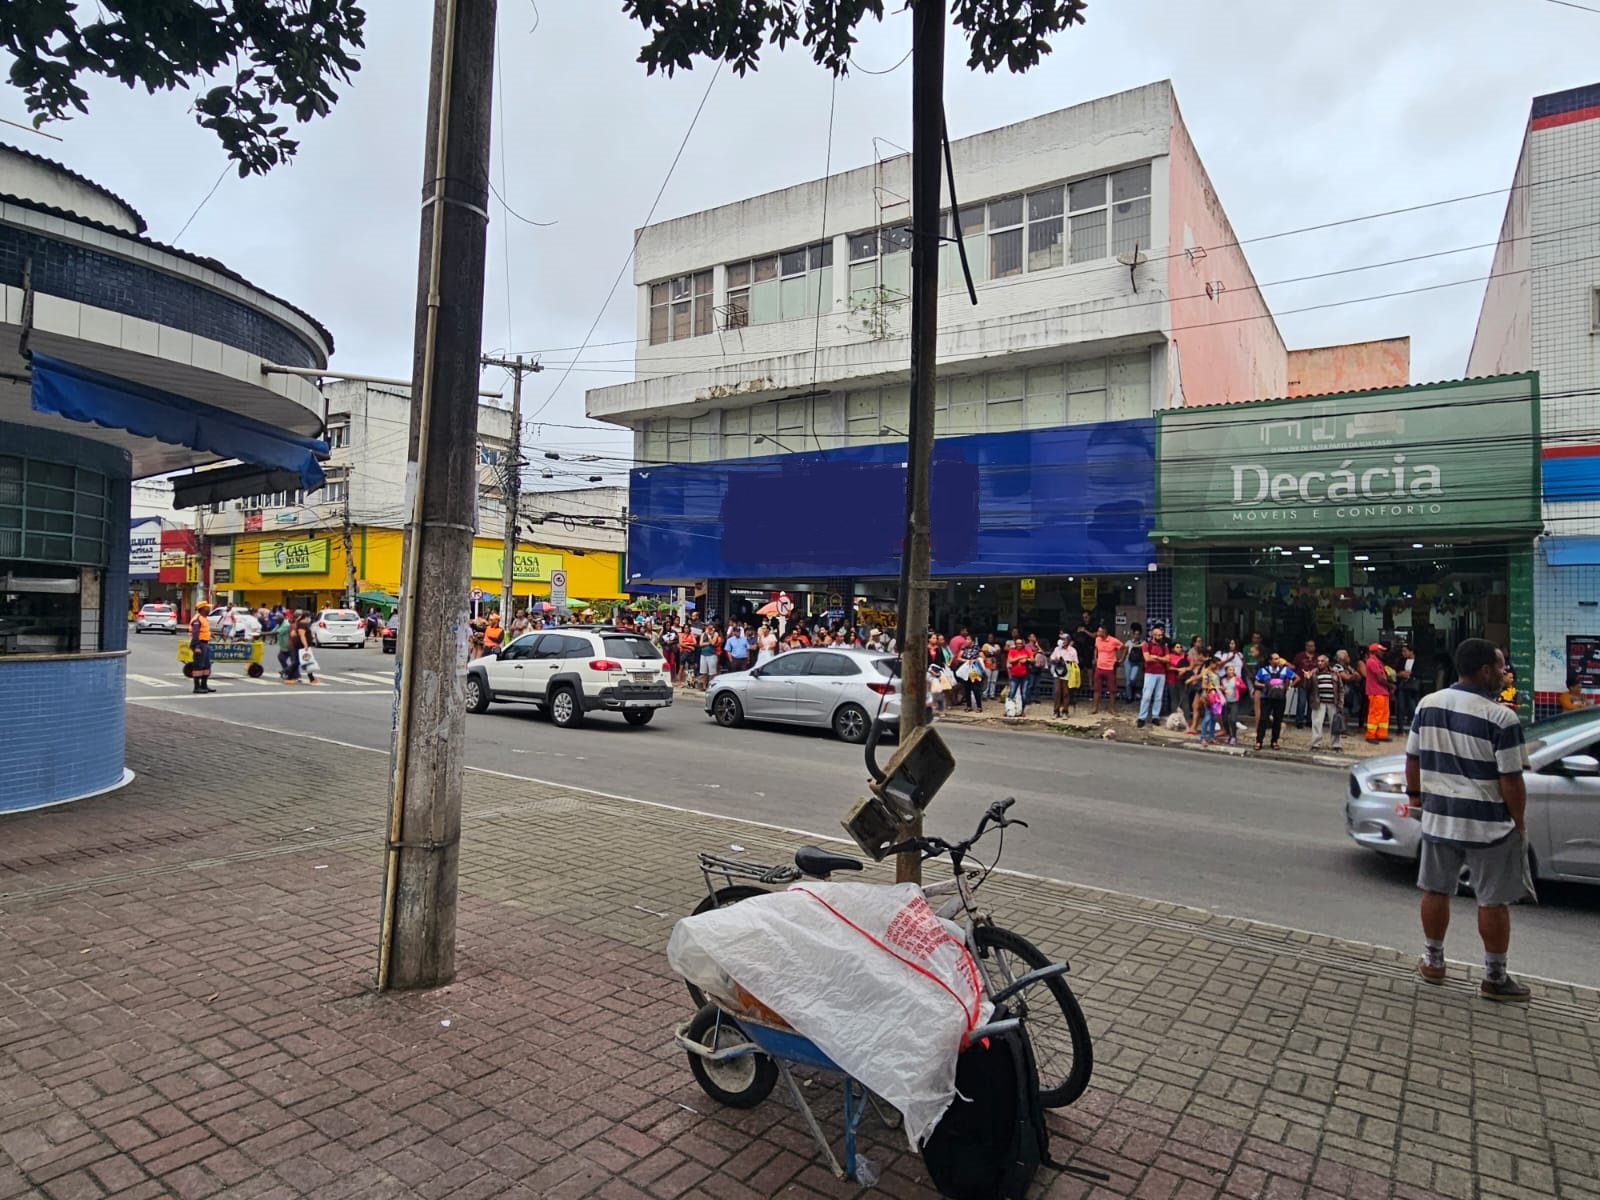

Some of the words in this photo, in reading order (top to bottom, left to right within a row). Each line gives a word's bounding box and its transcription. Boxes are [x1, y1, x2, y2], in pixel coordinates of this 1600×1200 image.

[1230, 453, 1445, 506] Decácia
[1232, 510, 1297, 521] MÓVEIS
[1313, 510, 1320, 519] E
[1336, 504, 1441, 518] CONFORTO
[286, 545, 309, 557] CASA
[514, 555, 540, 566] CASA
